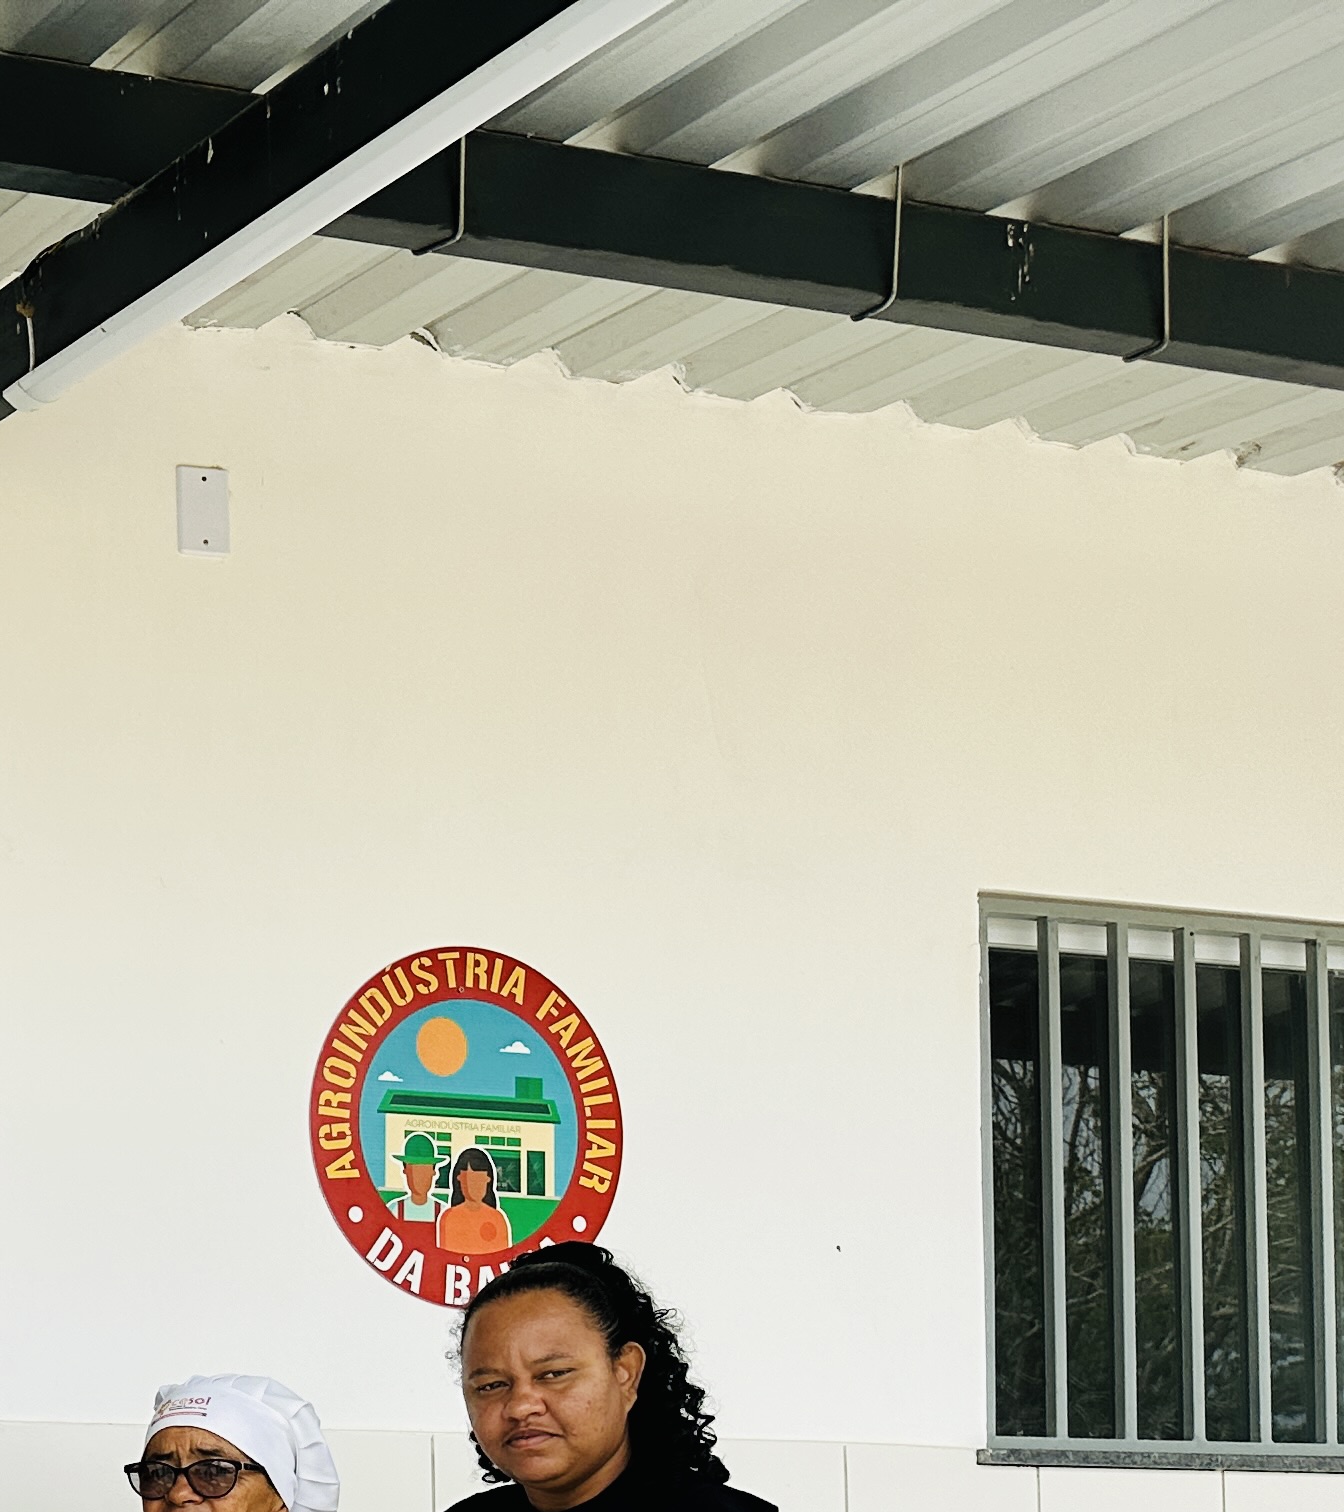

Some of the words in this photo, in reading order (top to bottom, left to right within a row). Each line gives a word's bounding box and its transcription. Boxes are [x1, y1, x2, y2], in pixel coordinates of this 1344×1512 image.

[317, 951, 526, 1180] AGROINDÚSTRIA
[535, 989, 617, 1194] FAMILIAR
[364, 1226, 425, 1296] DA
